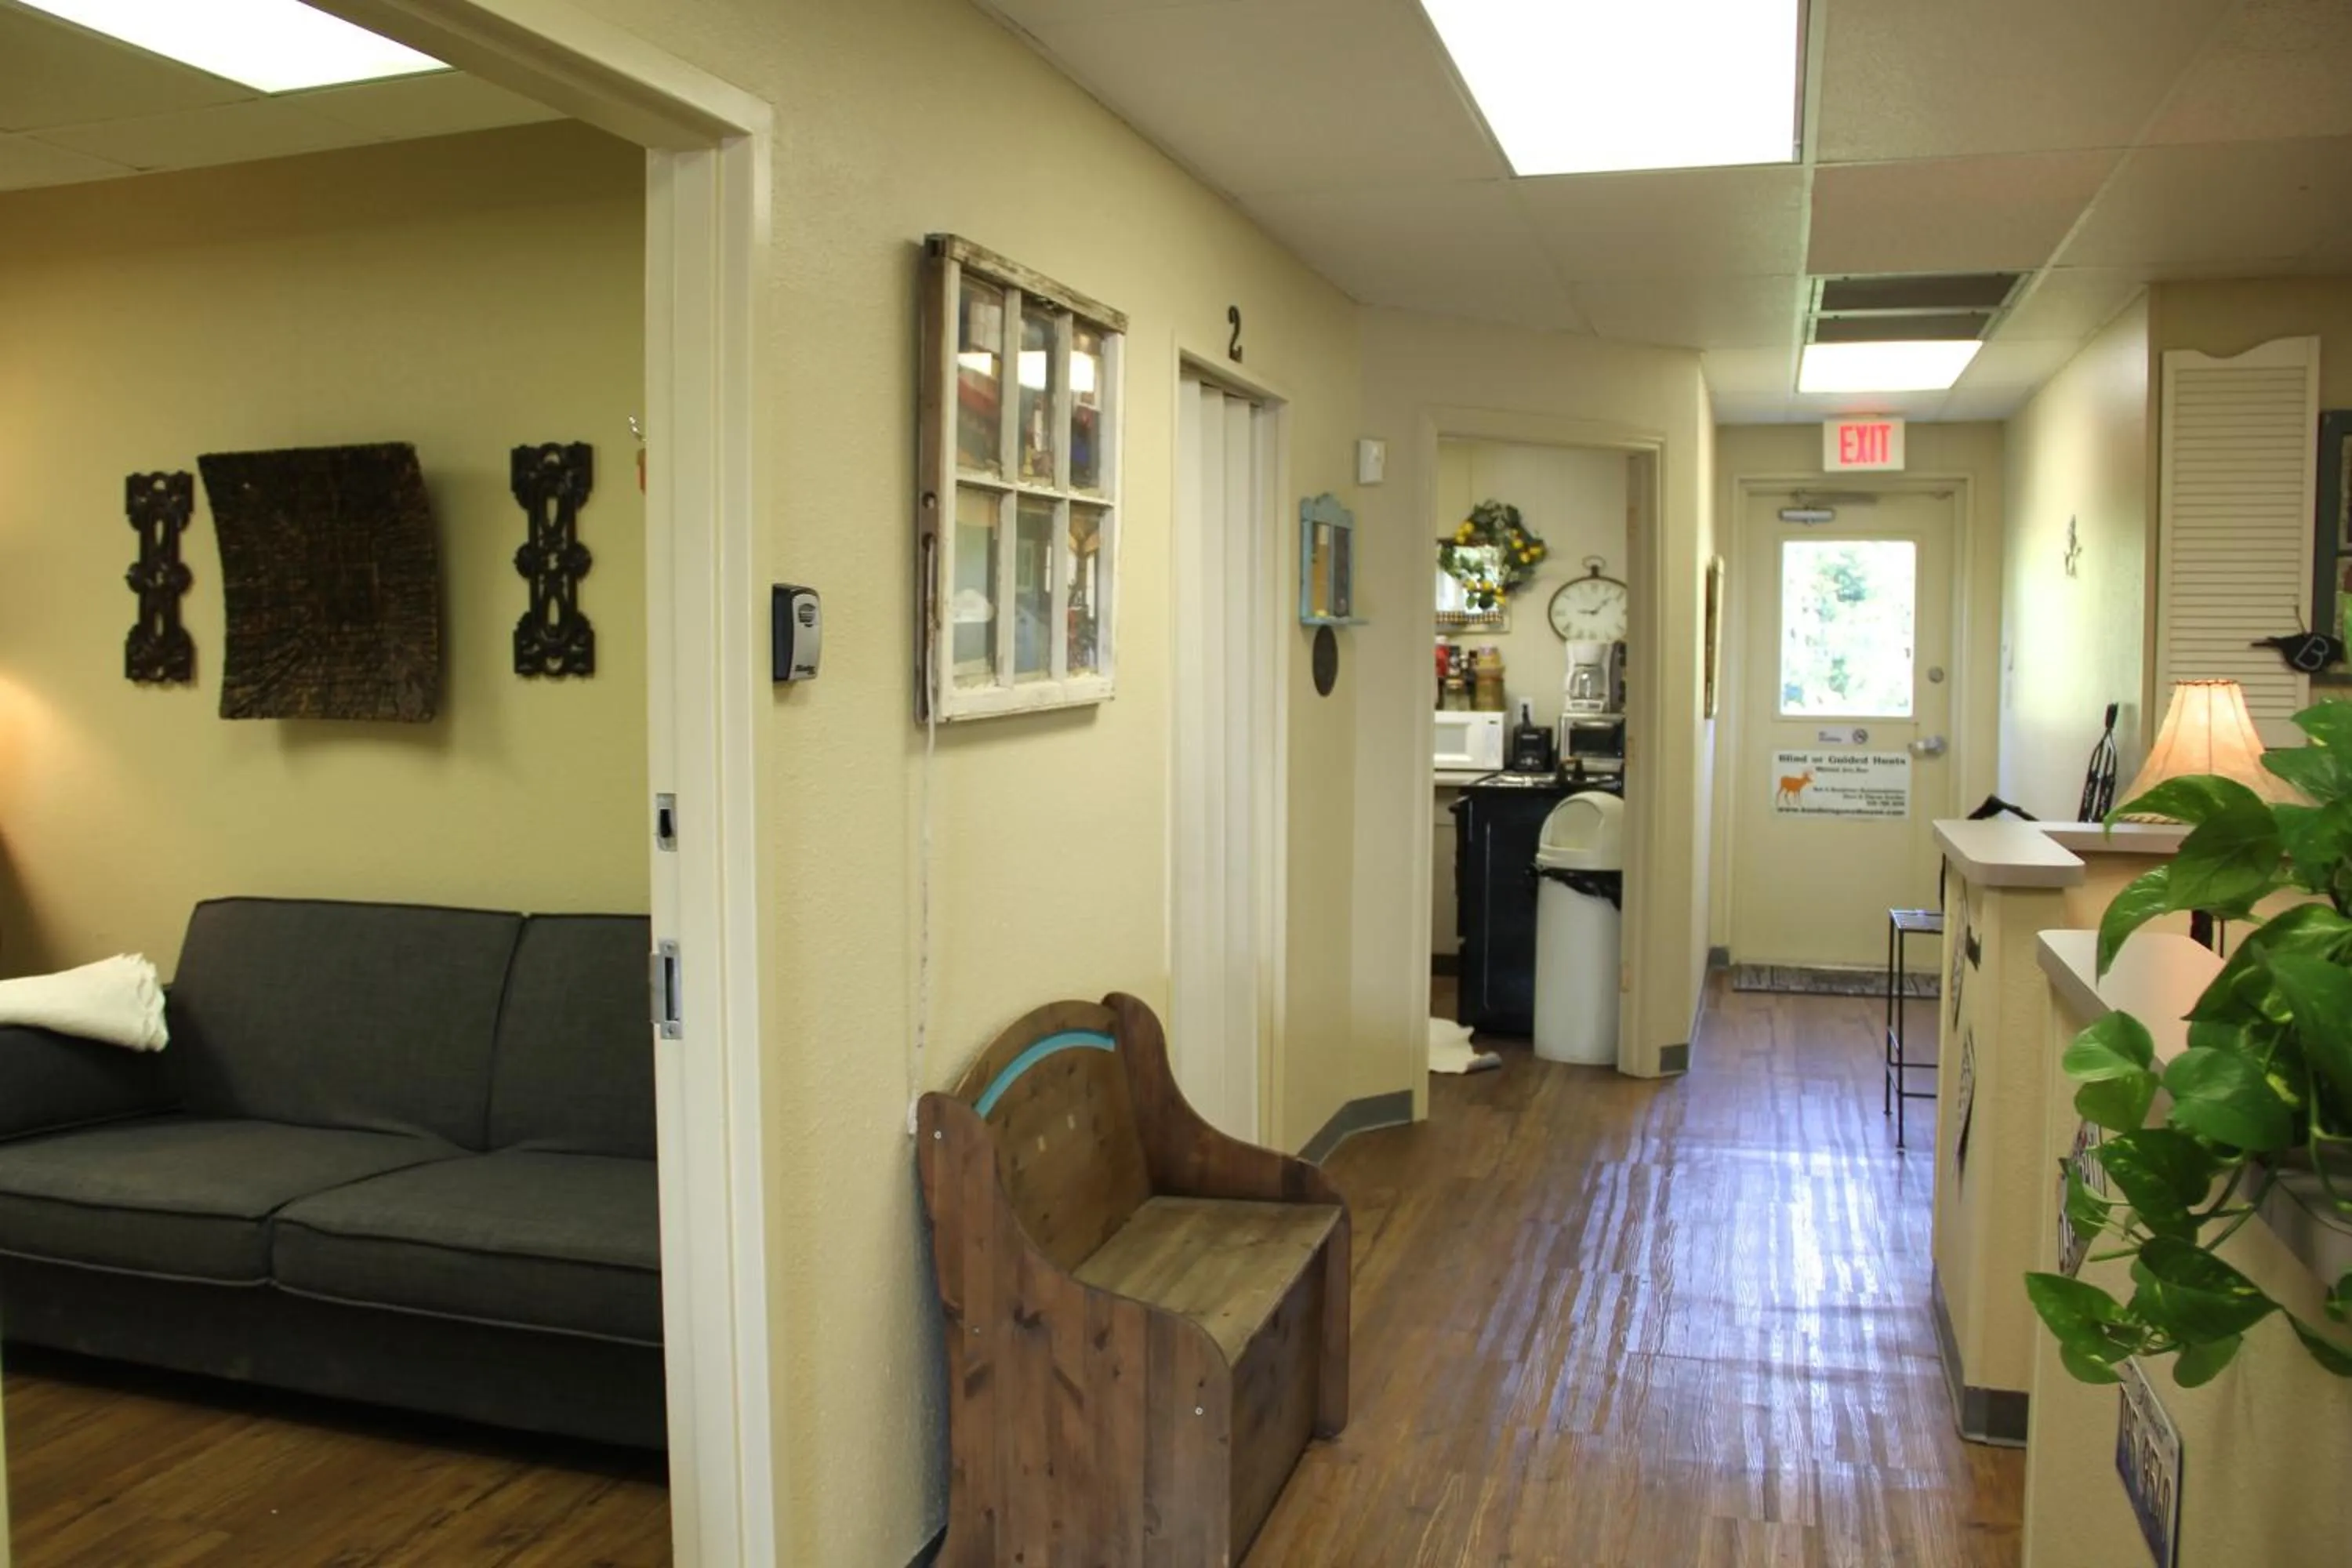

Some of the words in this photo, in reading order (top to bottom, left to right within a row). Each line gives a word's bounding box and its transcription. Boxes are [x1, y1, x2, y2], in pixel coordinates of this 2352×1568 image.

[1229, 305, 1243, 363] 2
[1839, 424, 1891, 464] EXIT
[2294, 636, 2329, 671] B
[1828, 754, 1868, 764] Guided
